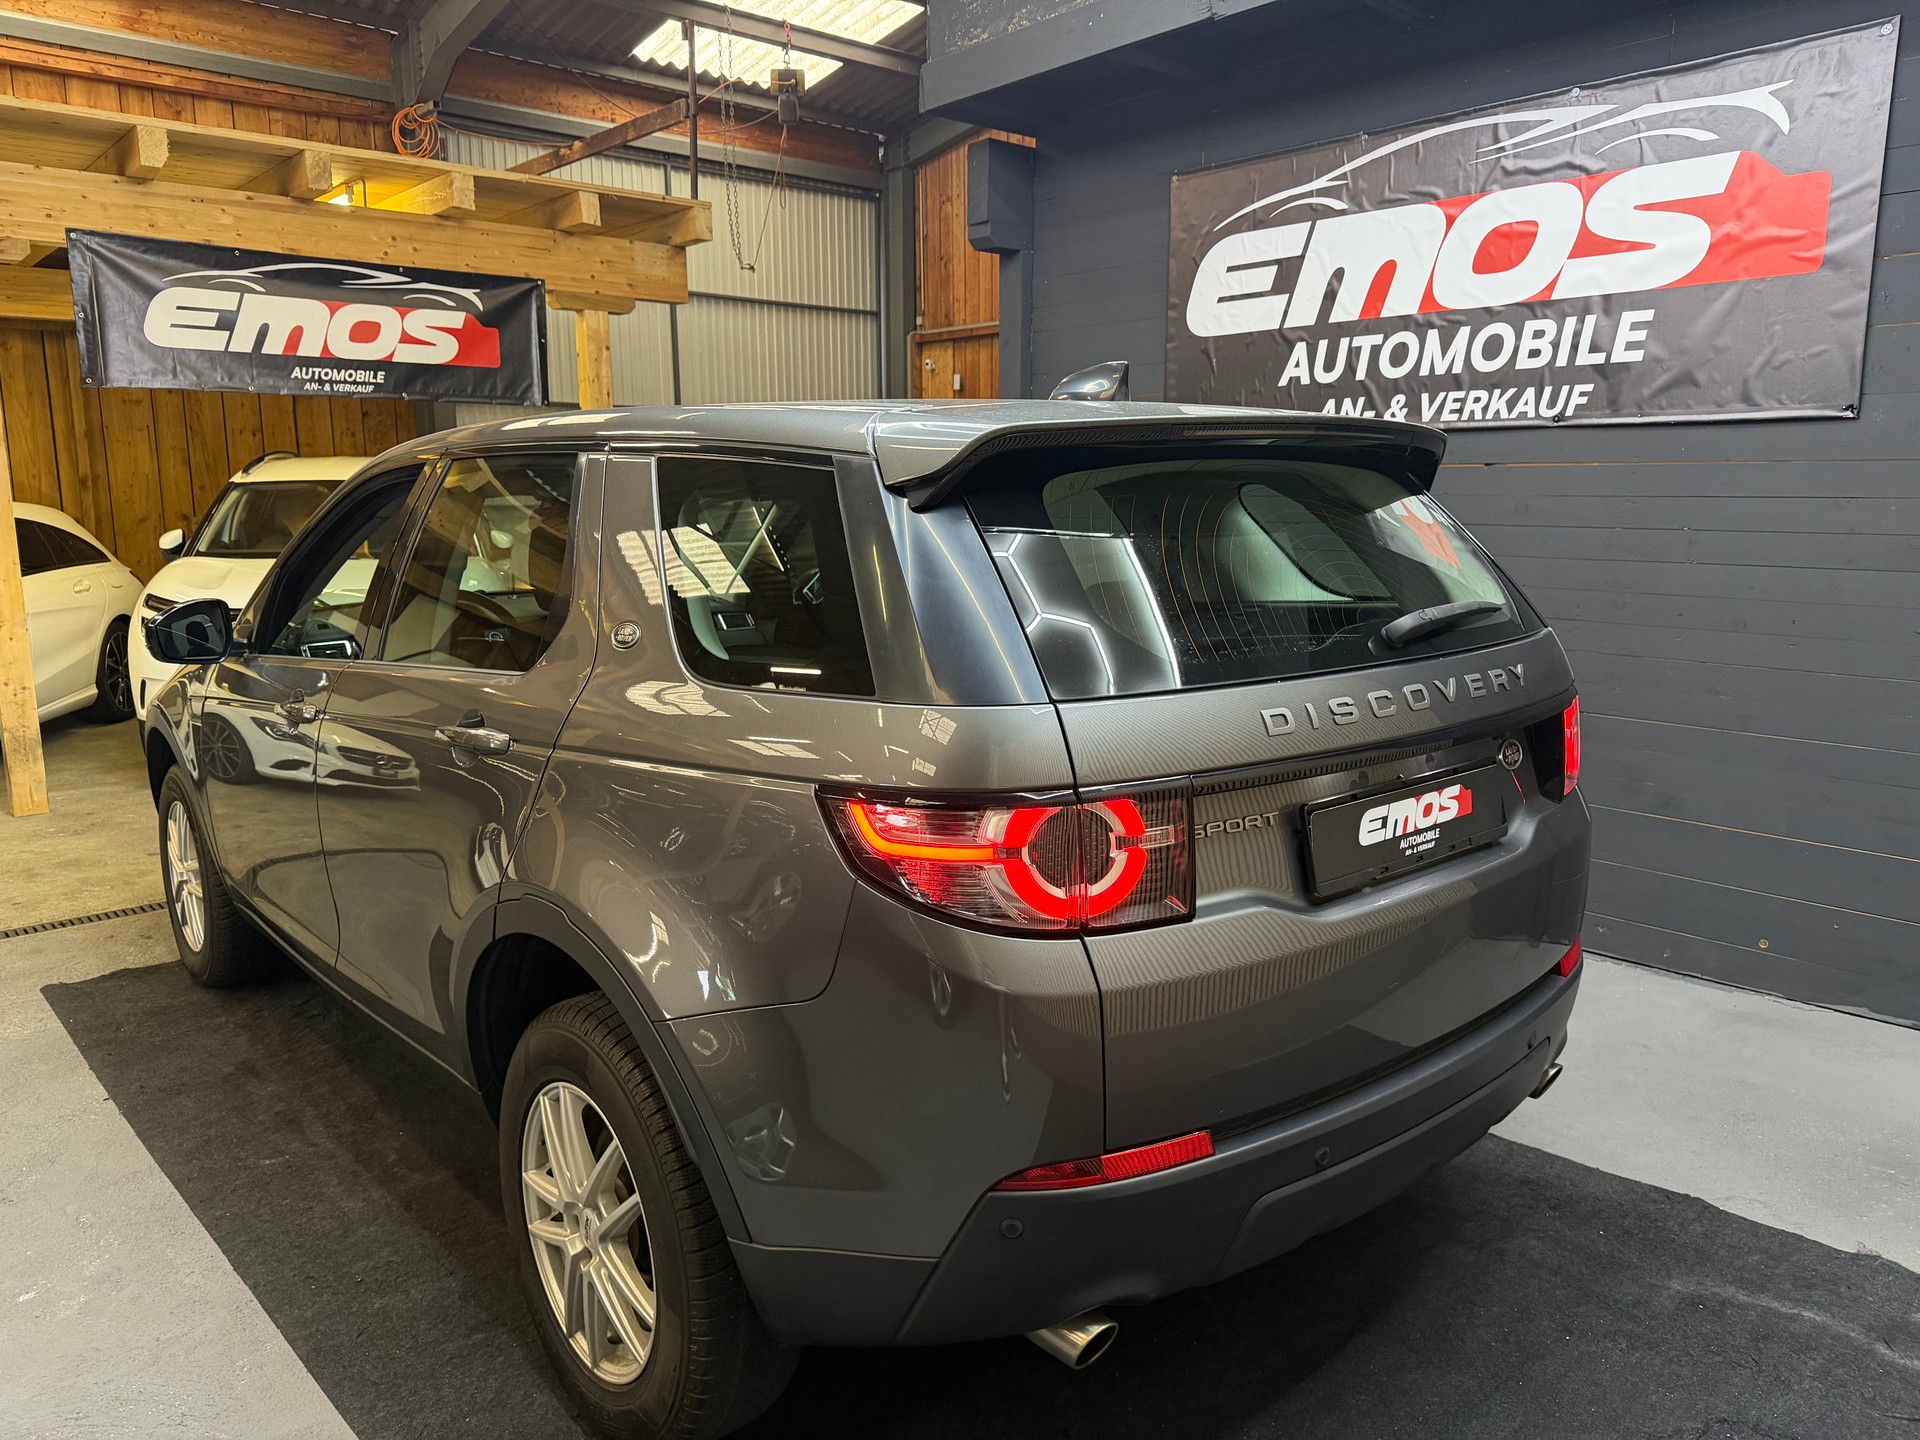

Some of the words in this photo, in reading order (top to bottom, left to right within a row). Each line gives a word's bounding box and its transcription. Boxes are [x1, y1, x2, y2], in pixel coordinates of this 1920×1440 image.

[1278, 308, 1656, 388] AUTOMOBILE
[290, 366, 386, 384] AUTOMOBILE
[304, 381, 322, 392] AN-
[323, 383, 331, 392] &
[333, 383, 375, 394] VERKAUF
[1383, 393, 1409, 422] &
[1420, 383, 1595, 422] VERKAUF
[1260, 663, 1527, 737] DISCOVERY
[1400, 828, 1440, 850] AUTOMOBILE
